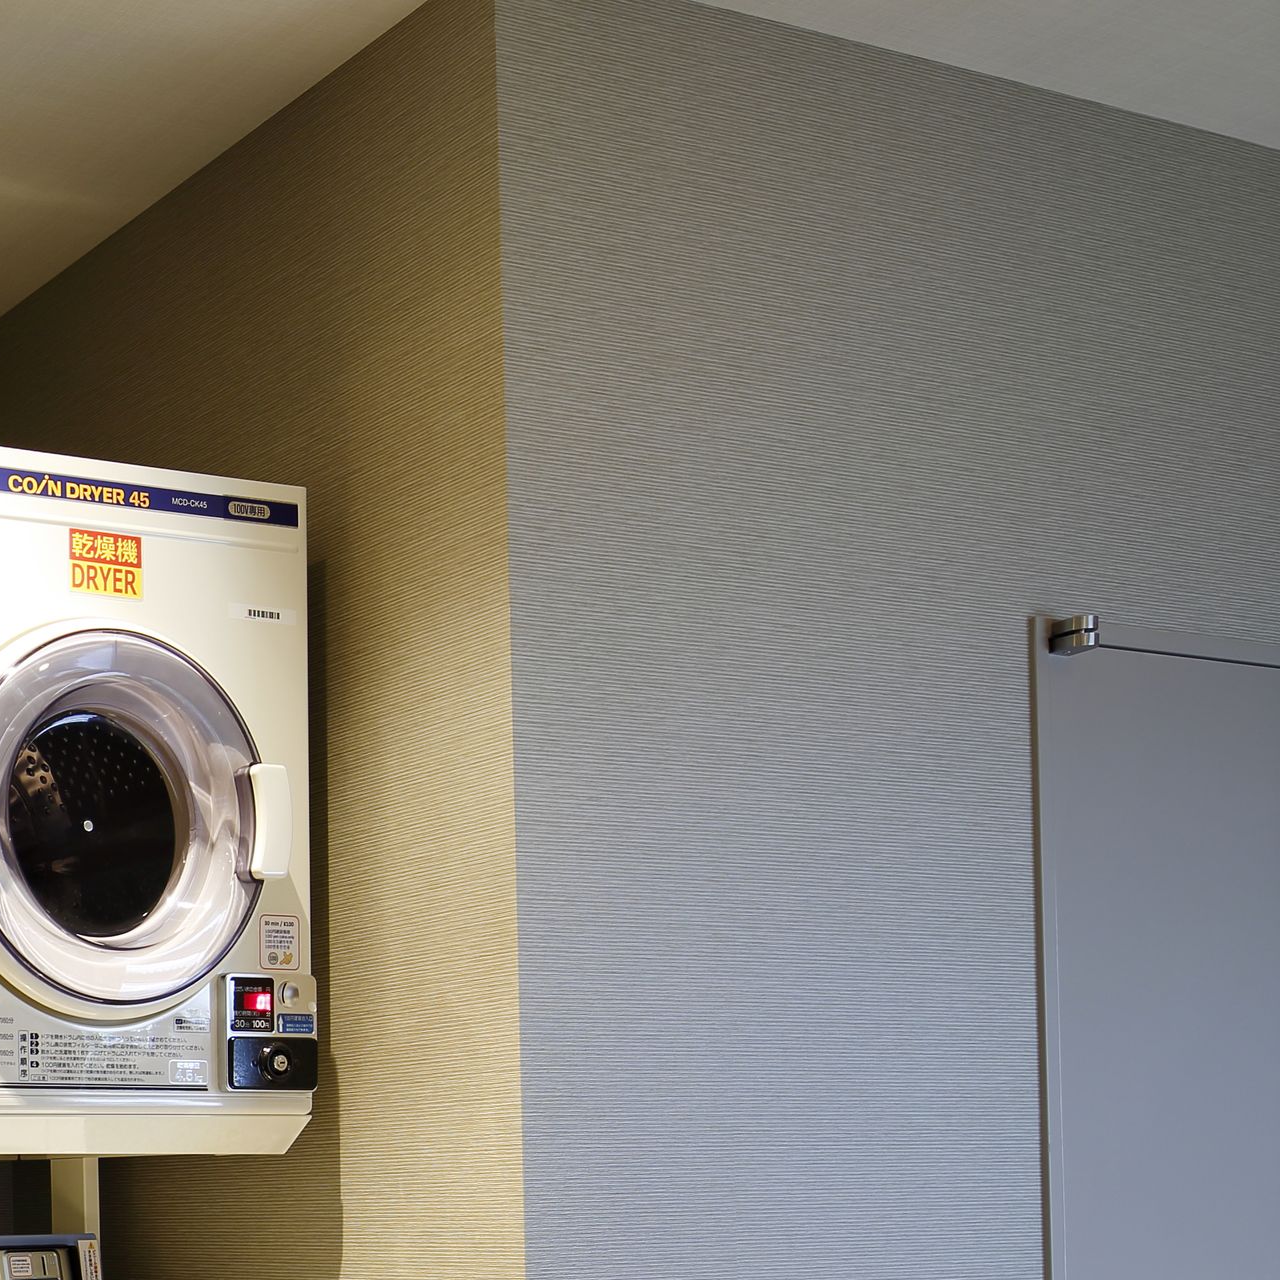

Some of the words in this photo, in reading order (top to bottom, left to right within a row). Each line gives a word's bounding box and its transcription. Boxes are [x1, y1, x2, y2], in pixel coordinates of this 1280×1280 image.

[65, 481, 125, 505] DRYER
[129, 490, 150, 509] 45
[171, 497, 208, 509] MCD-CK45
[232, 502, 267, 517] 100V専用
[71, 531, 139, 564] 乾燥機
[71, 562, 137, 595] DRYER
